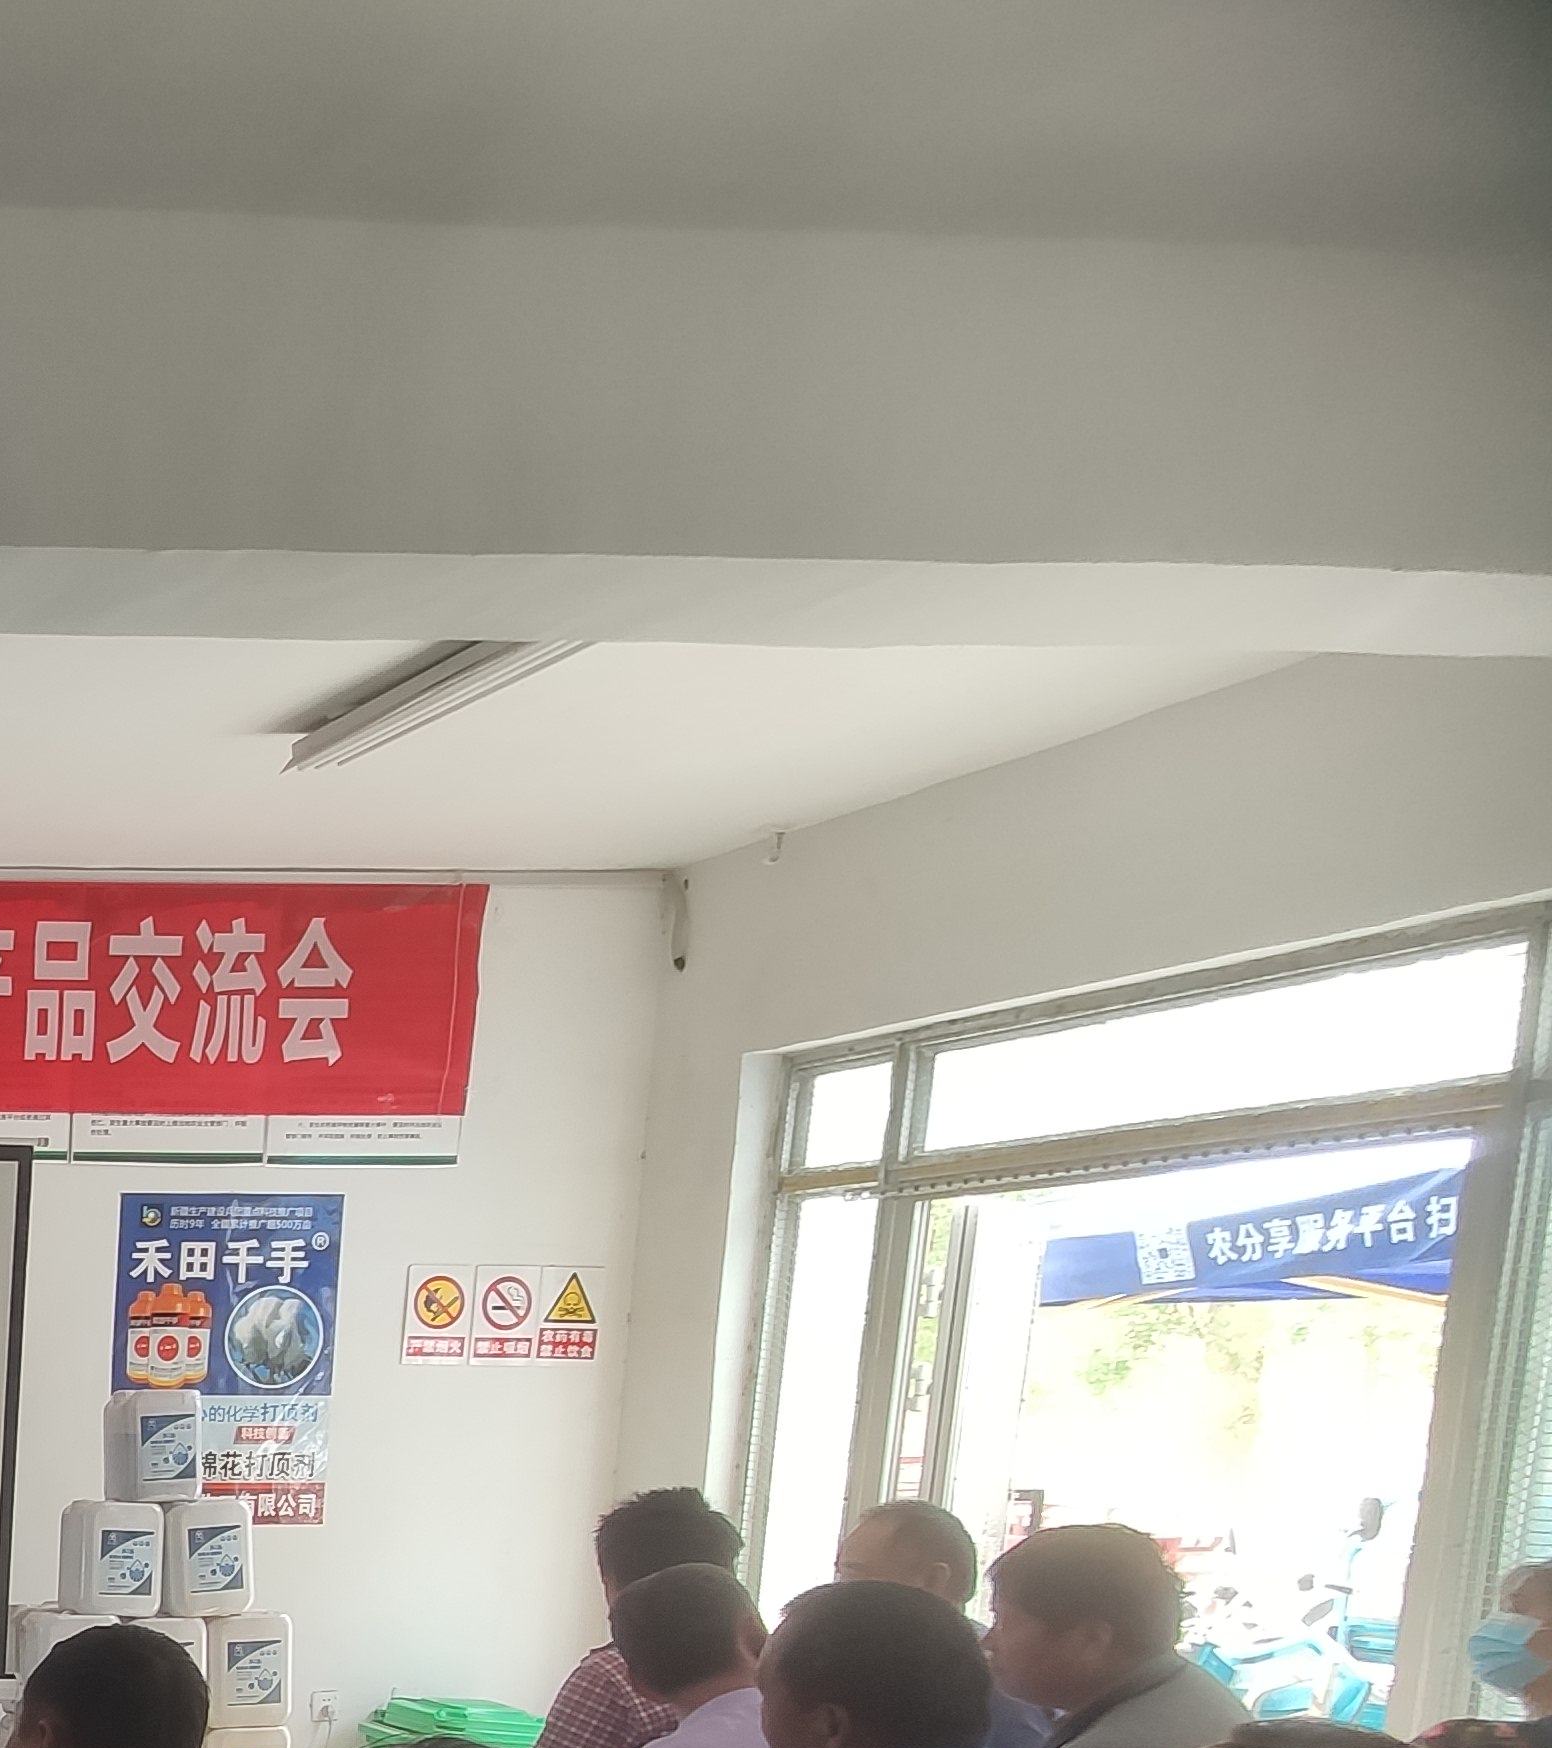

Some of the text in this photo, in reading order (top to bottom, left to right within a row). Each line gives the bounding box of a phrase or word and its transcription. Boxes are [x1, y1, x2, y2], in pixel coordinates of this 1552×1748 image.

[169, 1219, 205, 1229] 历时9年
[1205, 1195, 1460, 1265] 农分享服务平台 扫
[129, 1238, 310, 1284] 禾田千手
[542, 1330, 594, 1343] 农药有毒
[407, 1339, 463, 1354] 严禁烟火
[475, 1341, 530, 1354] 禁止吸烟
[539, 1344, 593, 1358] 禁止饮食
[202, 1450, 316, 1478] 棉花打顶剂
